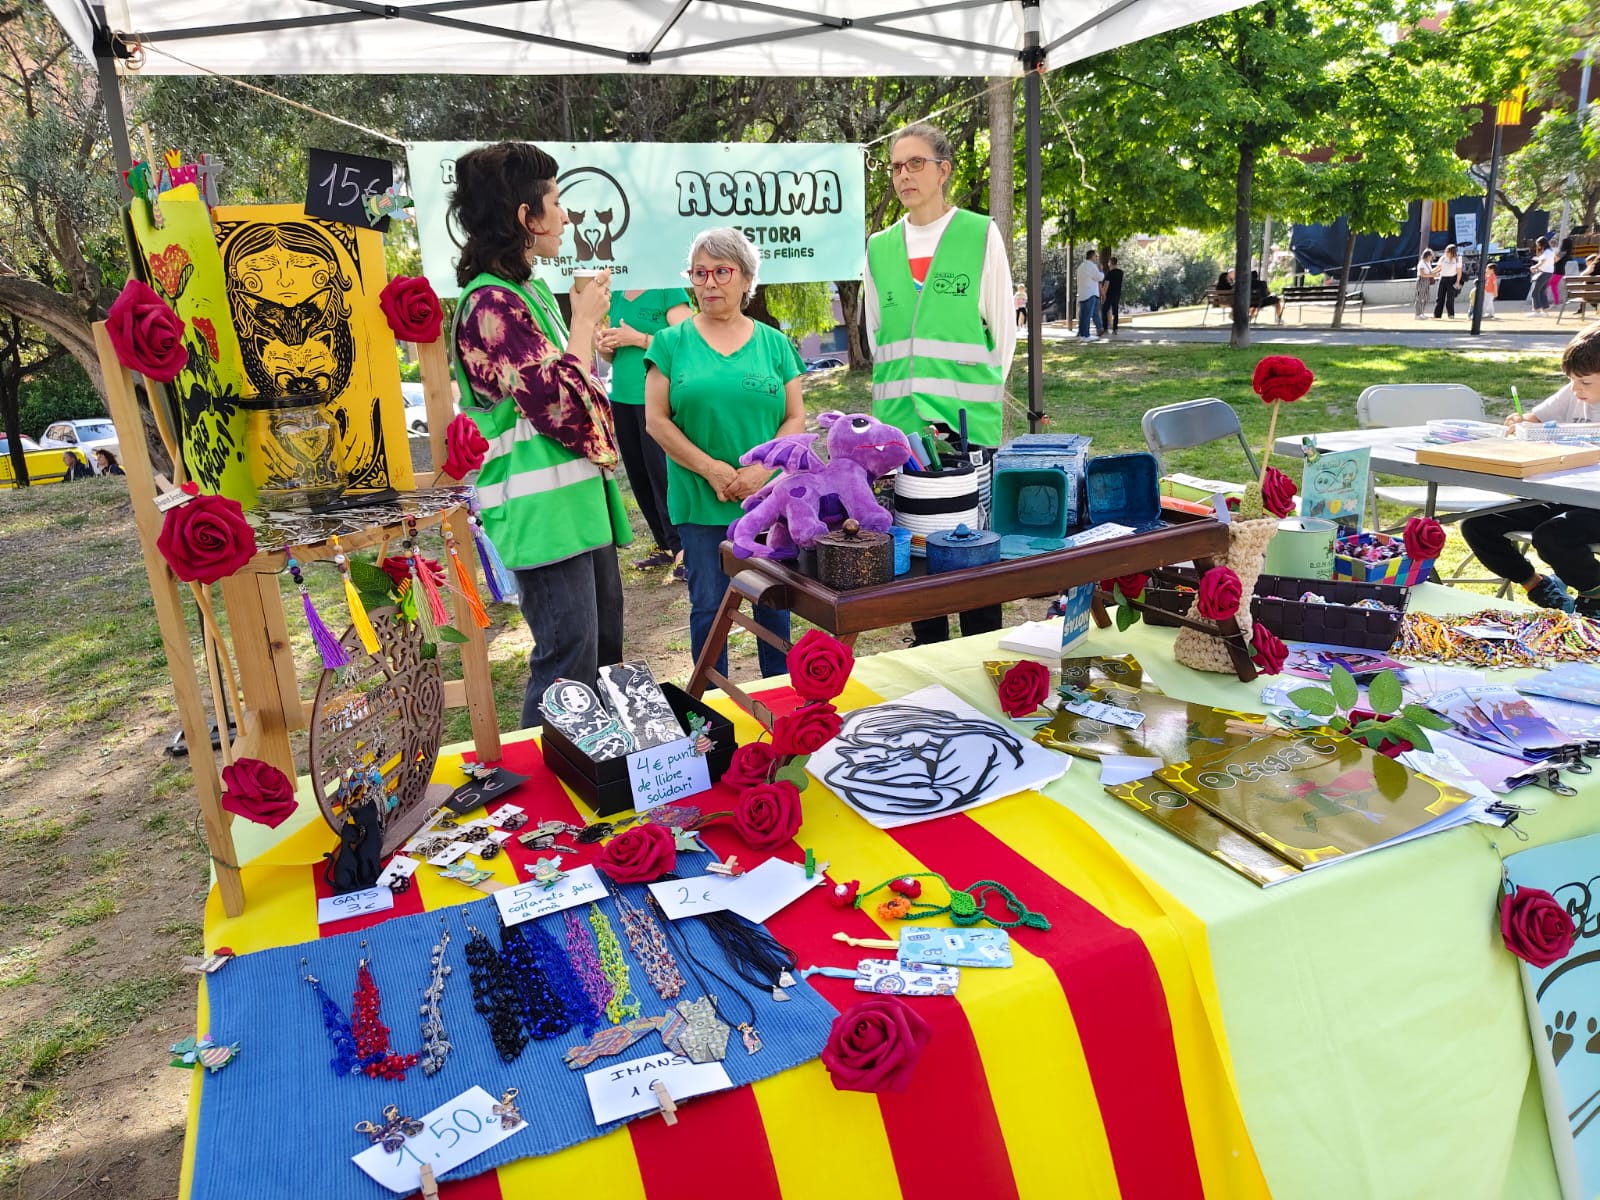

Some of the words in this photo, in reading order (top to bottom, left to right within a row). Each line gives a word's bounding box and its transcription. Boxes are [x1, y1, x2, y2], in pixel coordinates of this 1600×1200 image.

[676, 169, 842, 217] ACAIMA
[637, 775, 651, 793] de
[655, 769, 684, 786] llibre
[647, 776, 693, 804] solidari
[332, 890, 379, 906] GATS
[508, 890, 565, 913] collarets
[610, 1055, 687, 1081] IMANS
